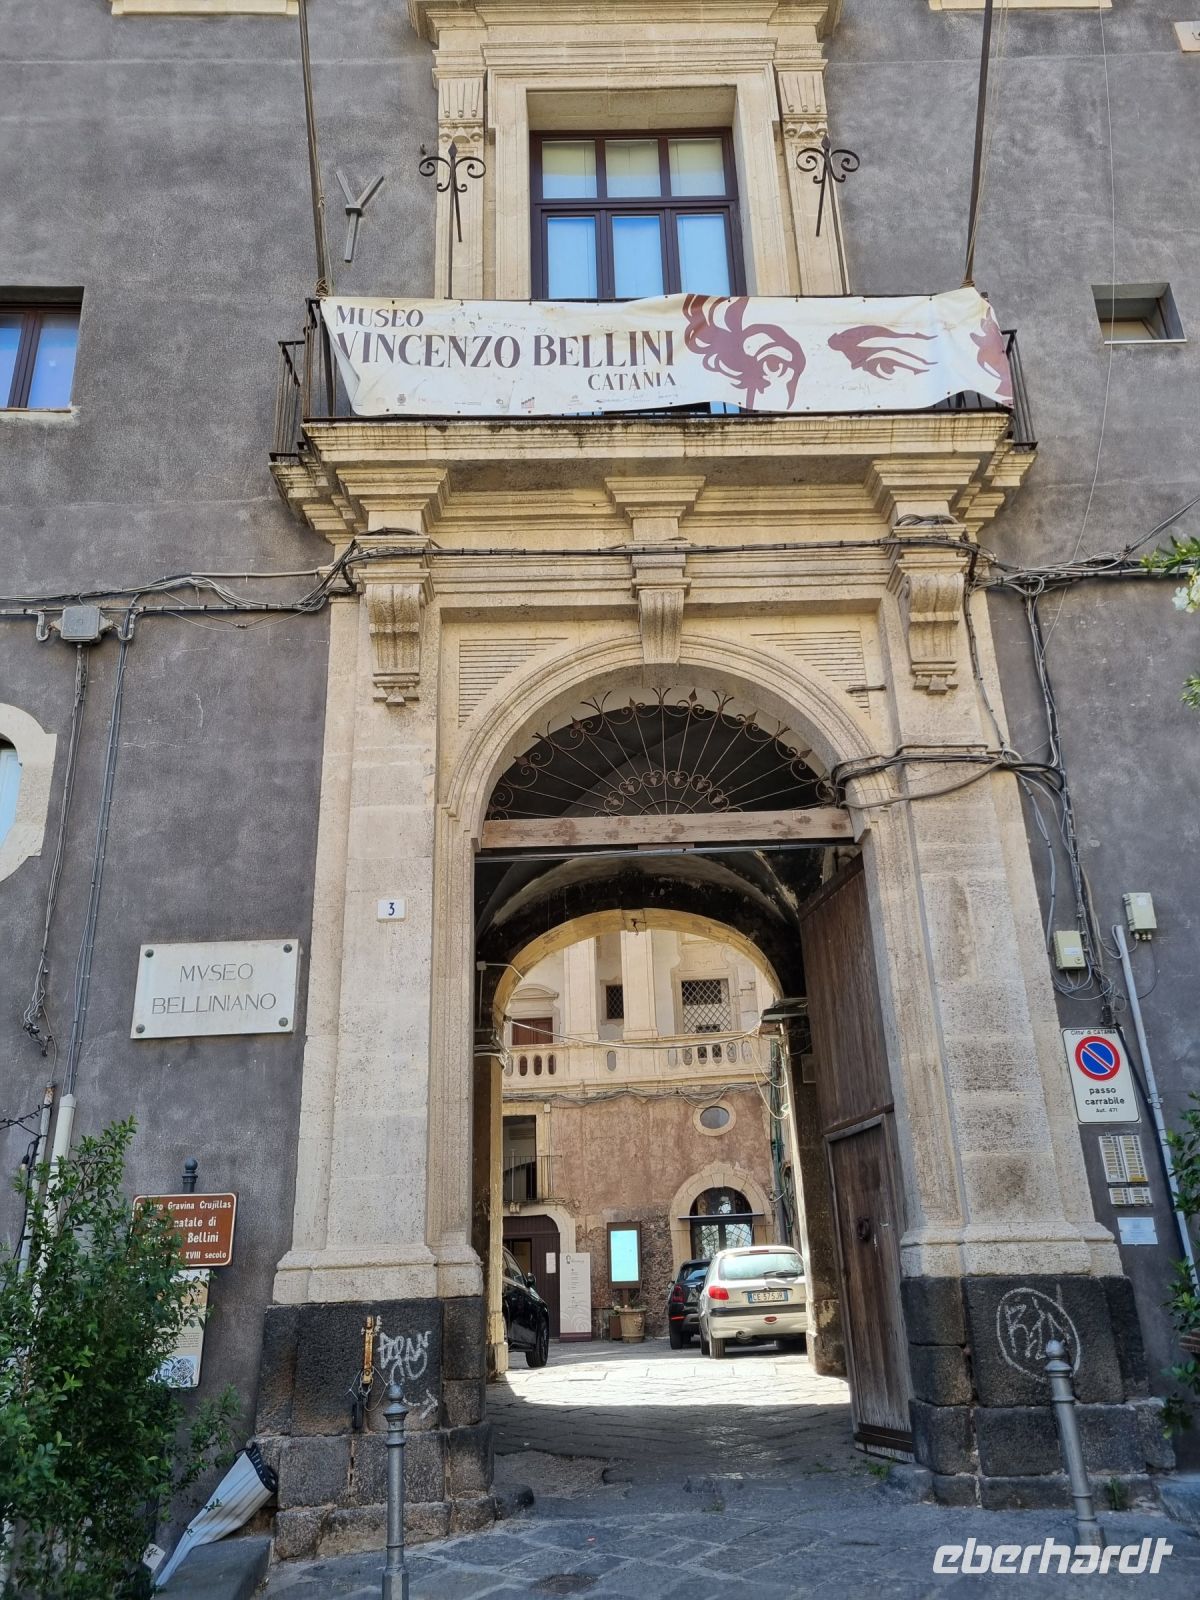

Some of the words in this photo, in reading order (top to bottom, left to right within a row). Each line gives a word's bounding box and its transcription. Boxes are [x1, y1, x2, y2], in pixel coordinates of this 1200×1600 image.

[335, 305, 424, 328] MUSEO
[336, 331, 521, 369] VINCENZO
[533, 330, 675, 369] BELLINI
[588, 370, 676, 391] CATANIA
[388, 902, 395, 916] 3
[179, 963, 254, 983] MVSEO
[151, 993, 277, 1015] BELLINIANO
[1089, 1087, 1117, 1096] passo
[1085, 1097, 1125, 1106] carrabile
[167, 1201, 195, 1210] Gravina
[200, 1200, 232, 1210] Crujillas
[173, 1217, 203, 1228] natale
[208, 1216, 217, 1227] di
[187, 1232, 219, 1243] Bellini
[185, 1251, 201, 1260] XVIII
[204, 1251, 227, 1259] secolo
